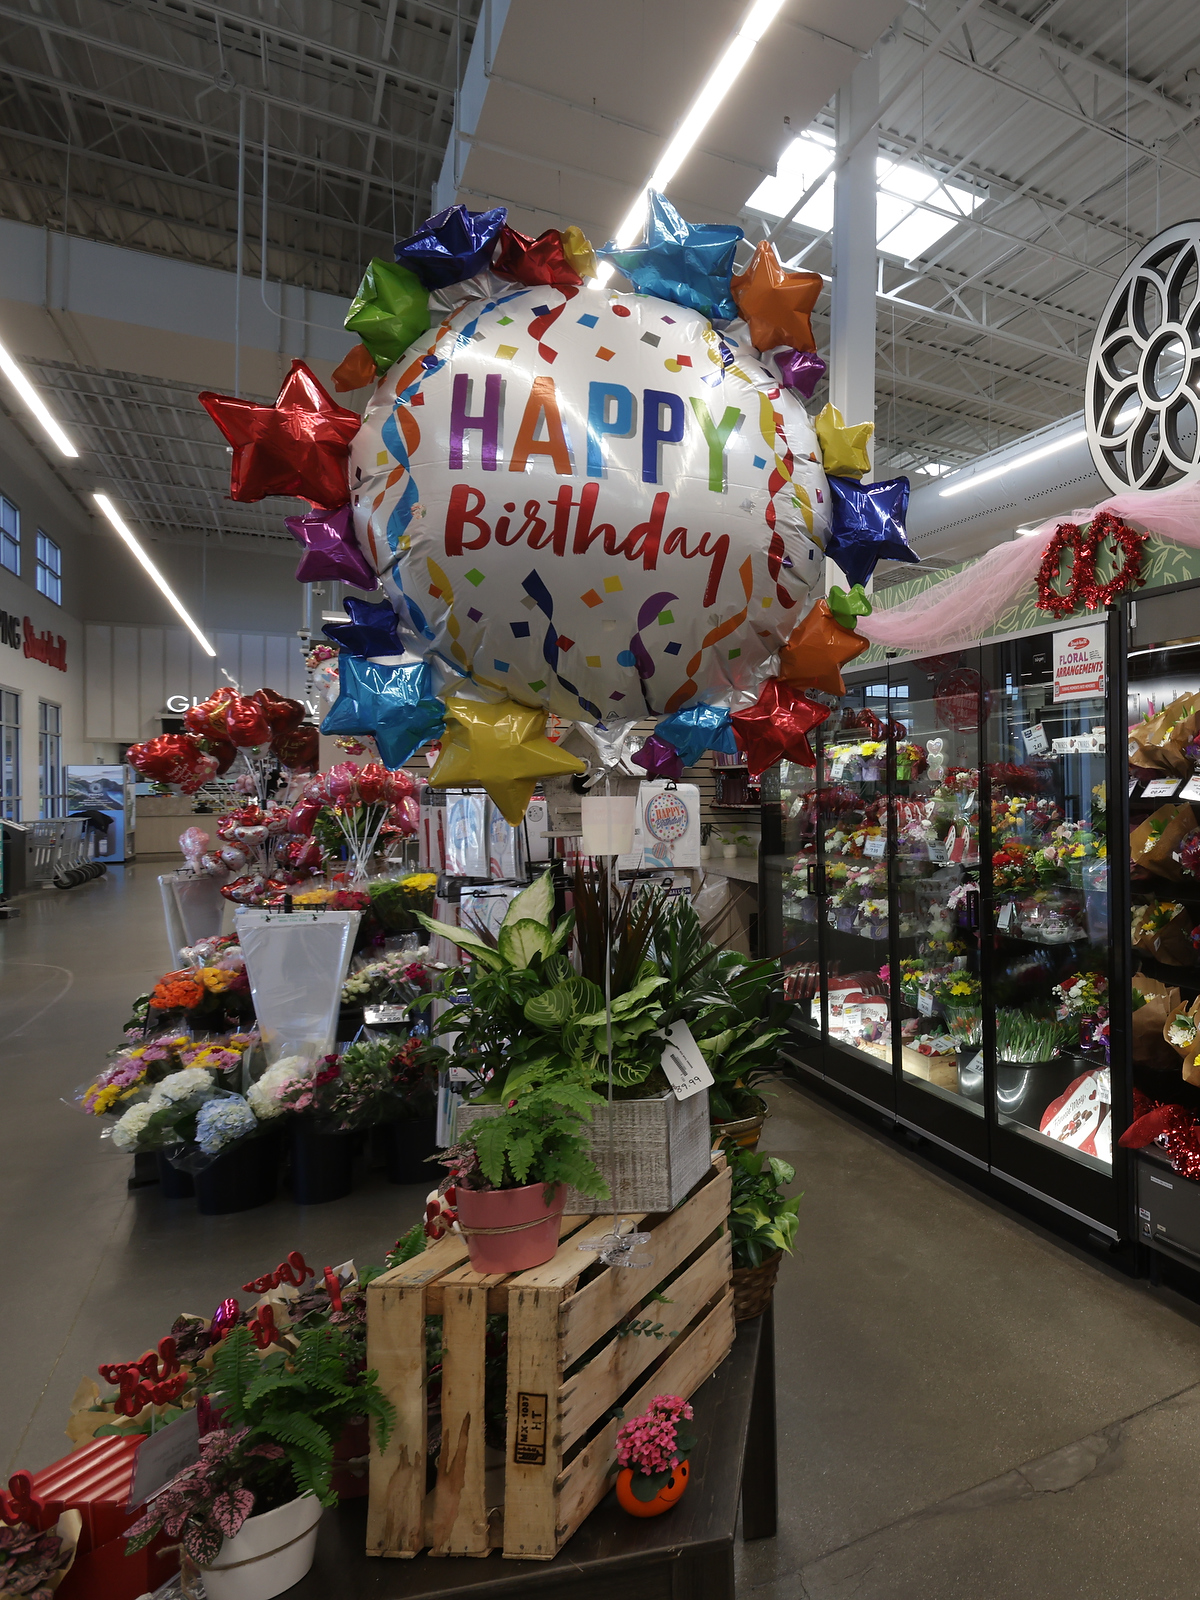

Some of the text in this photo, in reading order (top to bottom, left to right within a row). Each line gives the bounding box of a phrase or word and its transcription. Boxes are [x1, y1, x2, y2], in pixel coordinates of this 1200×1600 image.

[449, 373, 744, 494] HAPPY
[444, 481, 730, 604] Birthday
[0, 609, 21, 650] ING
[1056, 661, 1104, 678] ARRANGEMENTS
[1059, 651, 1089, 665] FLORAL
[655, 805, 681, 820] HAPPY
[520, 1395, 530, 1443] MX-1087
[531, 1410, 543, 1431] HT
